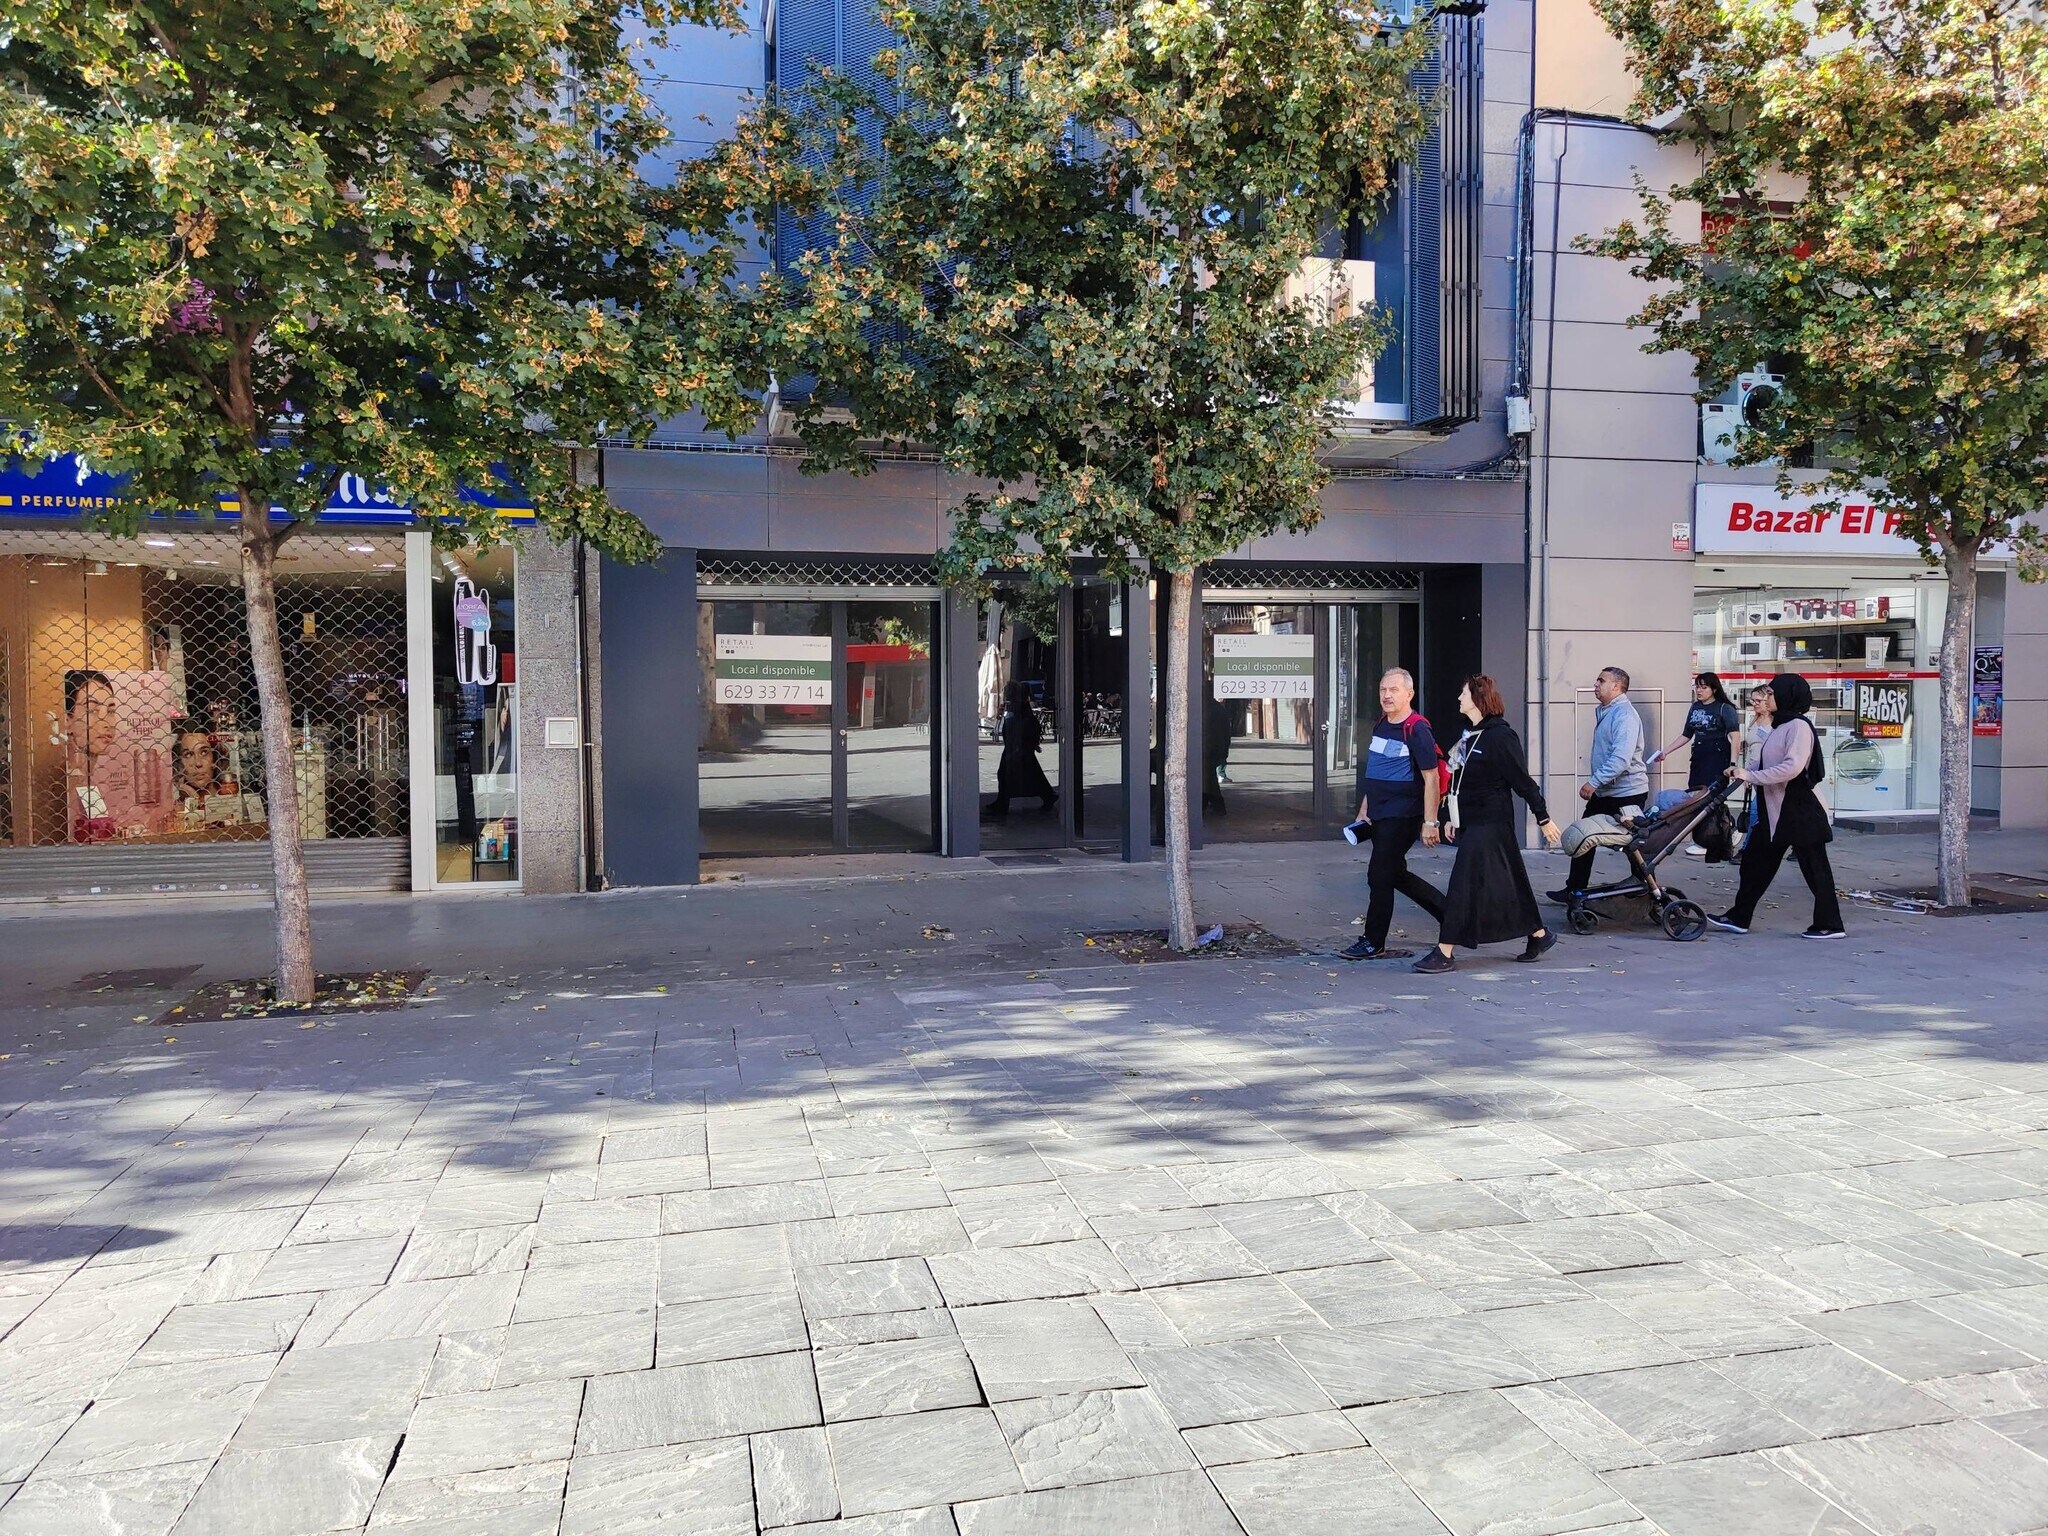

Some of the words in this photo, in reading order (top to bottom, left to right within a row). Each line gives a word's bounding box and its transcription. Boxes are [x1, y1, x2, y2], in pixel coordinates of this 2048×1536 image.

[1727, 502, 1832, 533] Bazar
[1840, 505, 1875, 534] El
[731, 664, 758, 674] Local
[762, 664, 816, 677] disponible
[1227, 662, 1250, 671] Local
[1253, 662, 1300, 672] disponible
[724, 685, 753, 698] 629
[758, 685, 777, 699] 33
[782, 685, 800, 699] 77
[807, 686, 824, 699] 14
[1221, 681, 1246, 693] 629
[1250, 681, 1266, 693] 33
[1271, 681, 1287, 693] 77
[1293, 681, 1307, 693] 14
[1860, 685, 1908, 709] BLACK
[1860, 701, 1907, 723] FRIDAY
[1882, 726, 1902, 736] REGAL
